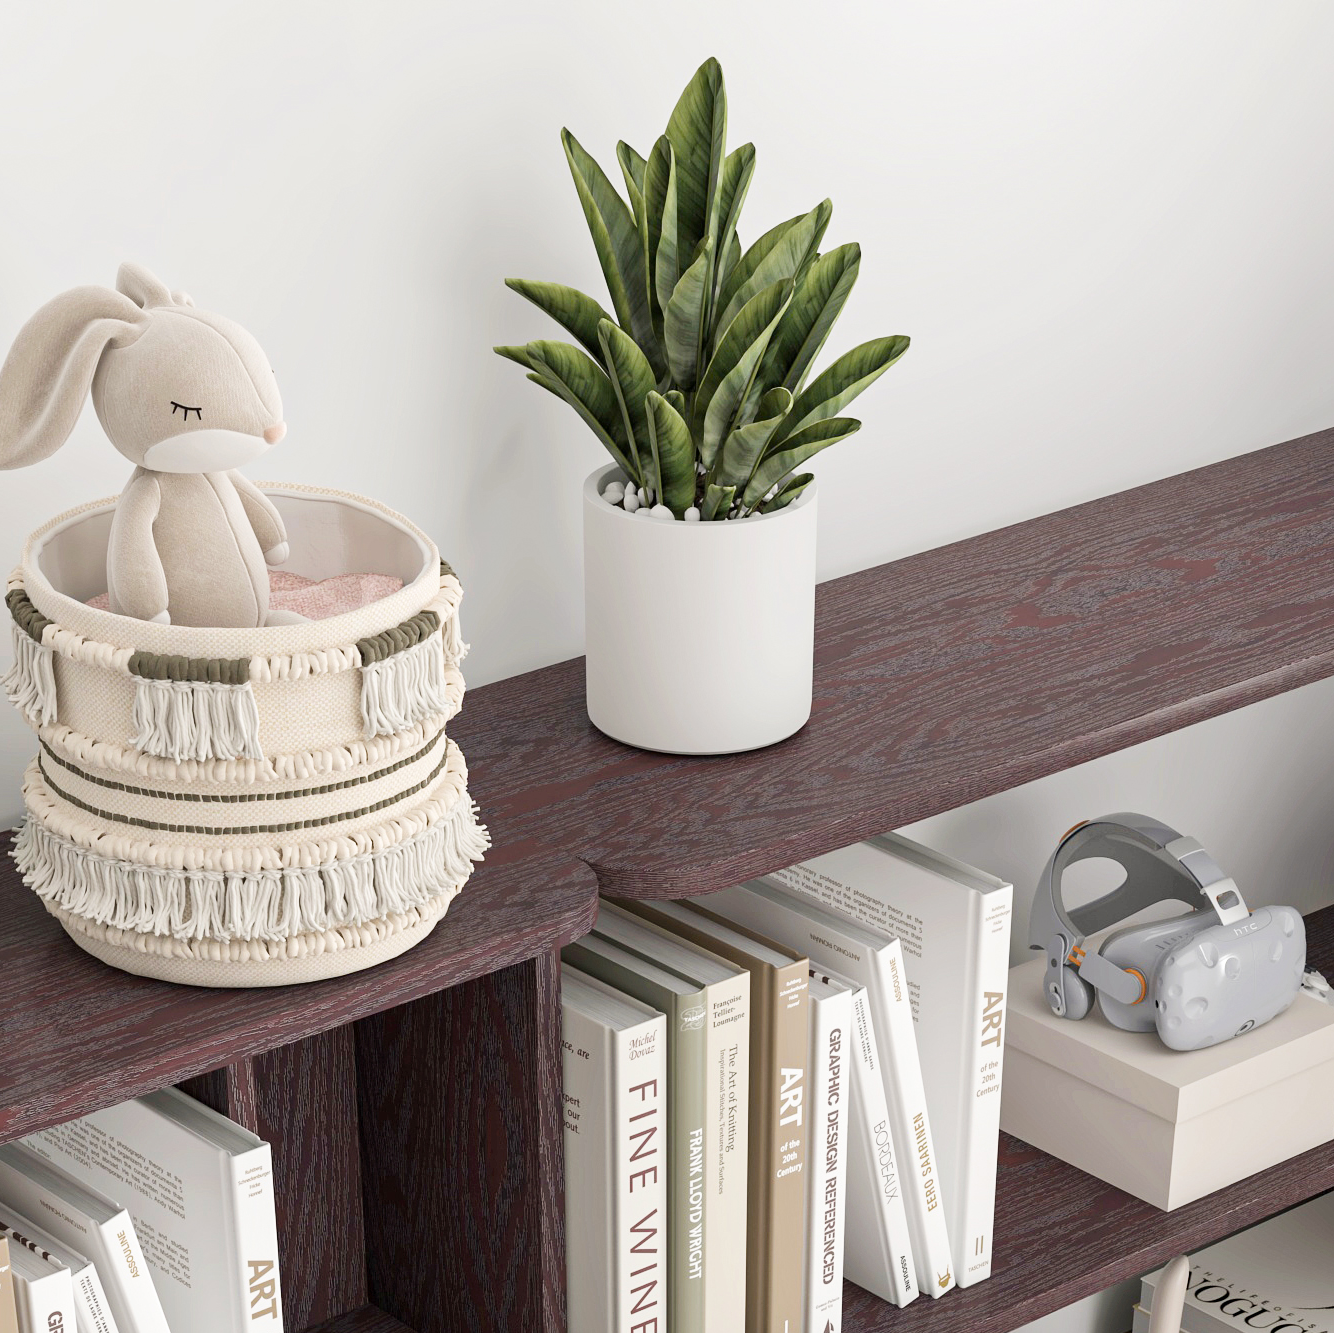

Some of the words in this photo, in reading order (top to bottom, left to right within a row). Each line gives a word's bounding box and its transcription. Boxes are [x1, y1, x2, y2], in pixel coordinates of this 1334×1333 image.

[980, 990, 1004, 1048] ART
[779, 1066, 803, 1127] ART
[827, 1027, 842, 1107] GRAPHIC
[629, 1079, 657, 1193] FINE
[825, 1110, 839, 1174] DESIGN
[873, 1120, 900, 1205] BORDEAUX
[117, 1230, 140, 1278] ASSOULINE
[822, 1177, 838, 1286] REFERENCED
[247, 1260, 278, 1321] ART
